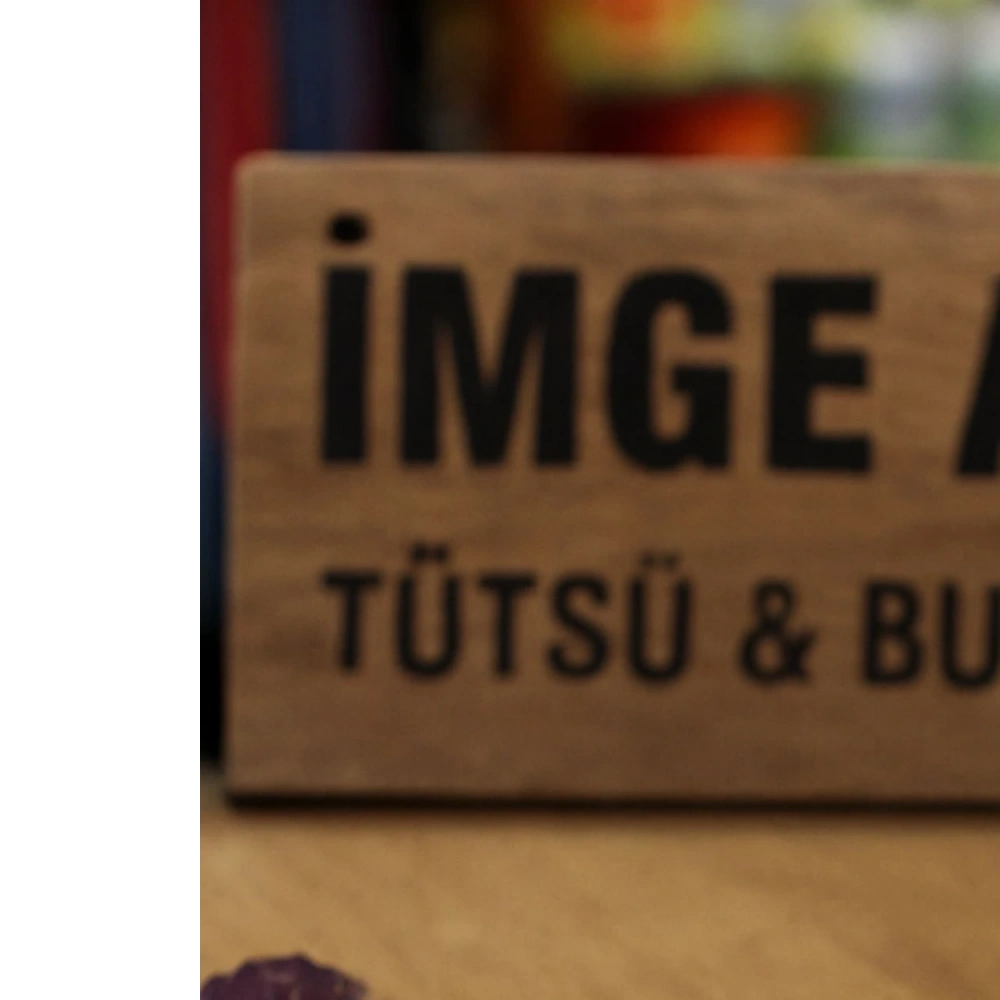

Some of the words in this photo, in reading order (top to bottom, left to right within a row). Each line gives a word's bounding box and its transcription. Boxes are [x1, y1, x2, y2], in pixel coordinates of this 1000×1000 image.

[320, 214, 880, 475] İMGE
[321, 543, 693, 684] TÜTSÜ
[738, 580, 816, 686] &
